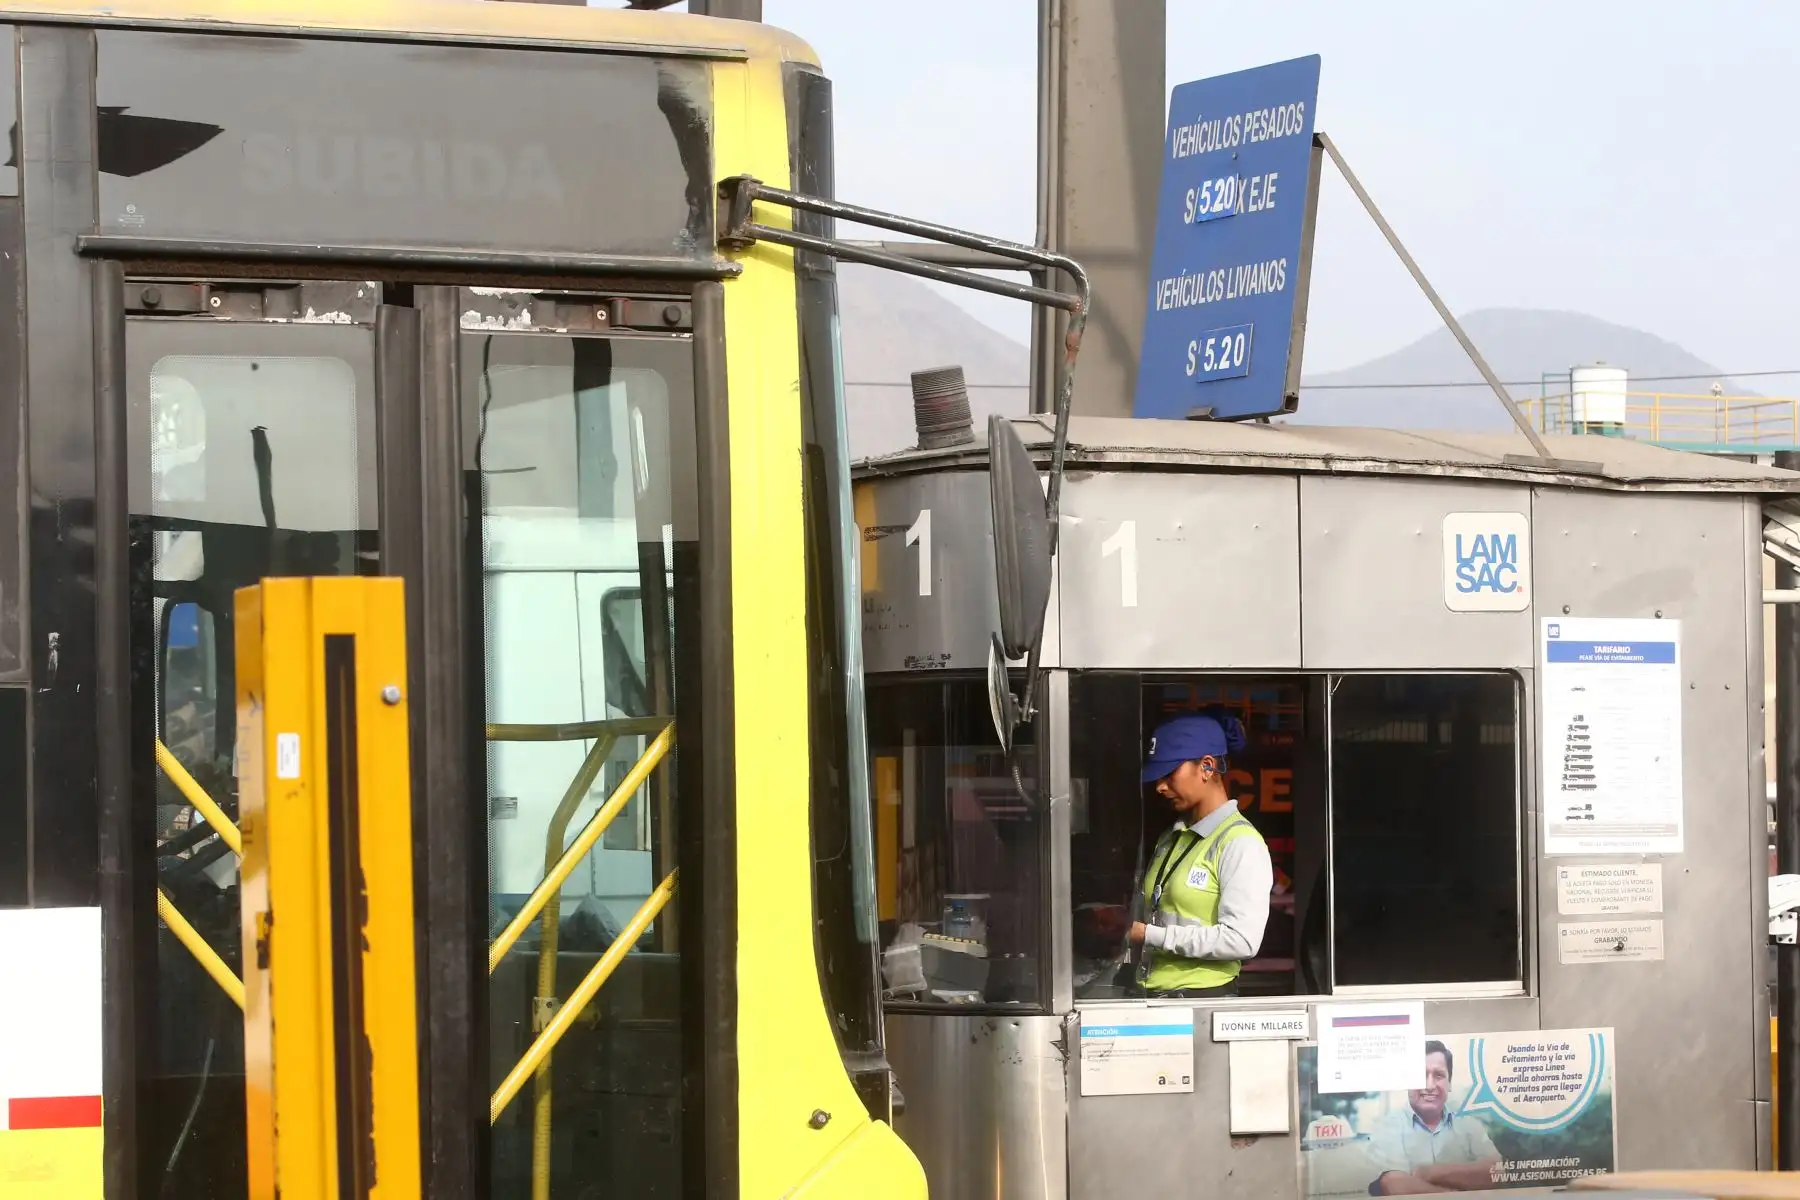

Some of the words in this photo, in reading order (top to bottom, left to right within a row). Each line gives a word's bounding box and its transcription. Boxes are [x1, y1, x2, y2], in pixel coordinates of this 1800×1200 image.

[1172, 114, 1241, 158] VEHÍCULOS
[1243, 102, 1304, 144] PESADOS
[239, 131, 565, 207] SUBIDA
[1200, 175, 1235, 214] 5.20
[1249, 172, 1278, 212] EJE
[1156, 268, 1225, 311] VEHÍCULOS
[1227, 258, 1286, 299] LIVIANOS
[1203, 333, 1245, 372] 5.20
[906, 509, 931, 596] 1
[1456, 534, 1516, 563] LAM
[1102, 520, 1137, 607] 1
[1456, 563, 1517, 593] SAC
[1593, 645, 1631, 653] TARIFARIO
[1594, 936, 1628, 944] GRABANDO
[1221, 1023, 1256, 1031] IVONNE
[1261, 1021, 1303, 1030] MILLARES
[1507, 1043, 1535, 1053] Usando
[1560, 1042, 1570, 1050] de
[1502, 1054, 1547, 1063] Evitamiento
[1549, 1055, 1554, 1063] y
[1496, 1074, 1529, 1083] Amarilla
[1531, 1074, 1560, 1082] ahorras
[1561, 1072, 1582, 1080] hasta
[1513, 1065, 1544, 1075] expresa
[1497, 1085, 1507, 1093] 47
[1509, 1084, 1540, 1092] minutos
[1541, 1085, 1558, 1094] para
[1560, 1082, 1582, 1092] llegar
[1513, 1095, 1520, 1103] al
[1315, 1124, 1342, 1137] TAXI
[1489, 1159, 1516, 1174] ¿MÁS
[1516, 1156, 1580, 1169] INFORMACIÓN?
